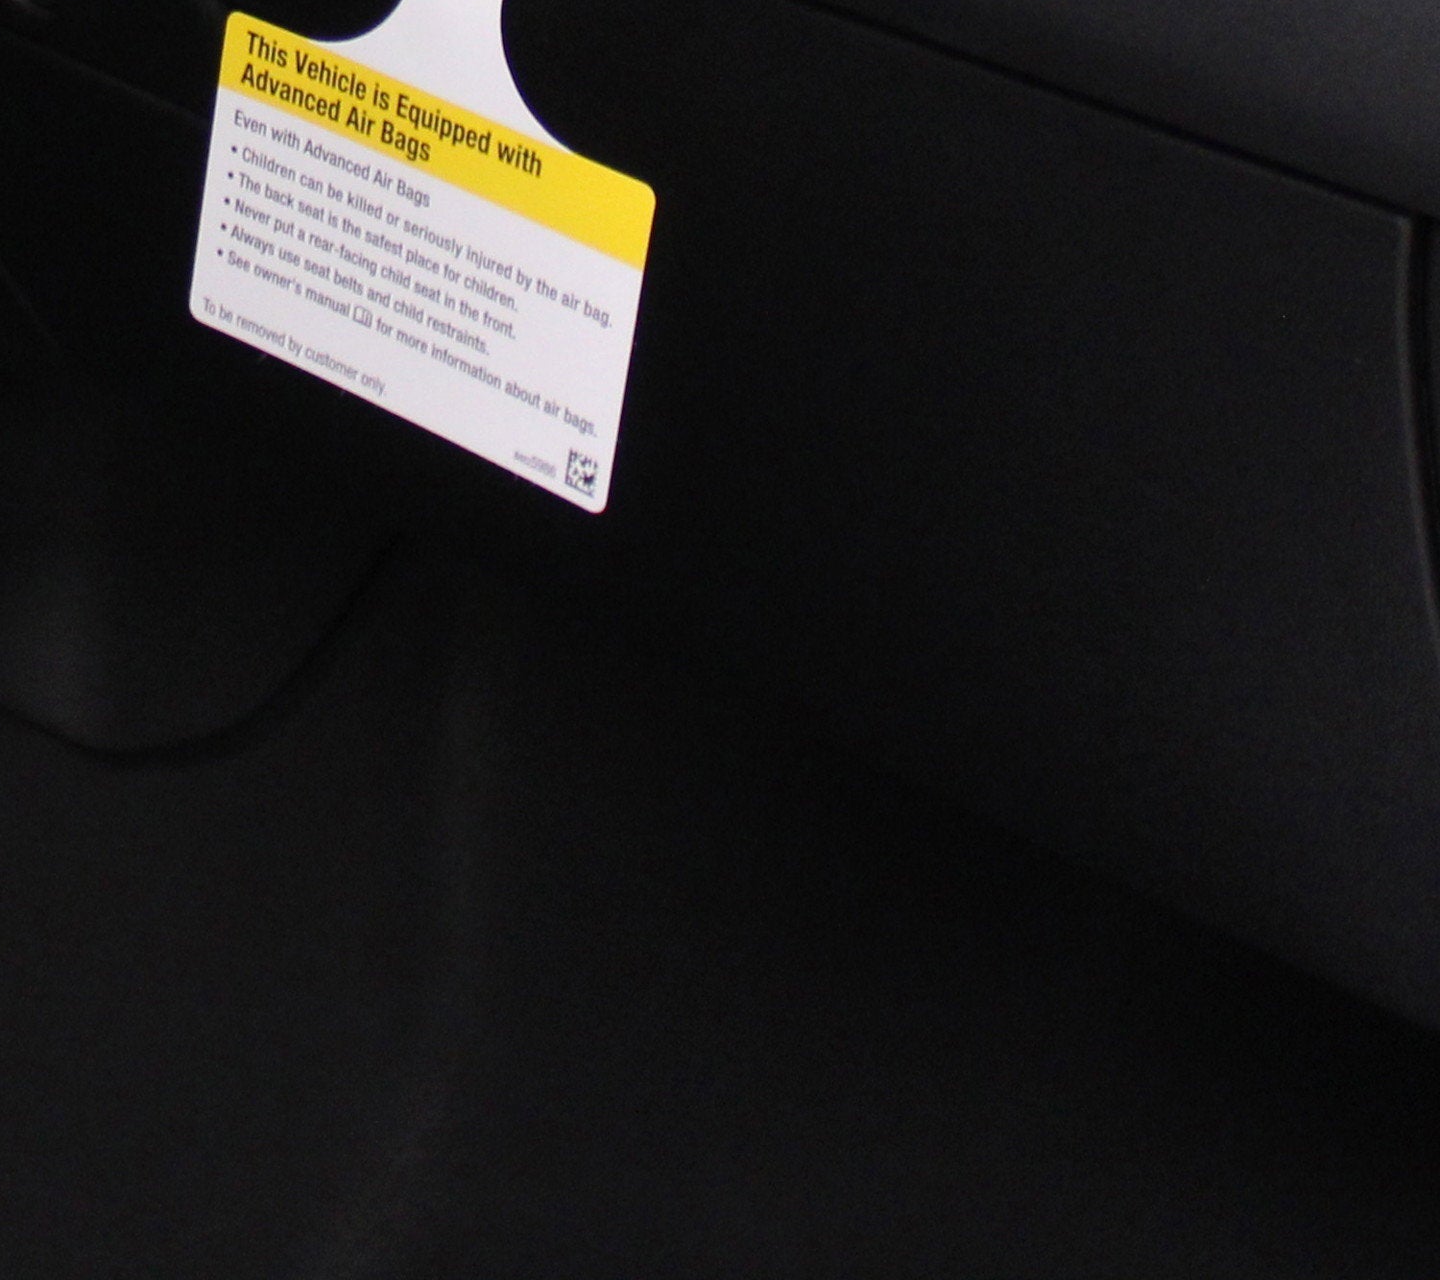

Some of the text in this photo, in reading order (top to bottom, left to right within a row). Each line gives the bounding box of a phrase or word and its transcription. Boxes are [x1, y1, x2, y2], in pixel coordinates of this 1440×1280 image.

[233, 107, 430, 207] Even with Advanced Air Bags
[239, 61, 430, 162] Advanced Air Bags
[246, 29, 542, 177] This Vehicle is Equipped with
[229, 223, 275, 256] Always
[277, 246, 301, 267] use
[302, 257, 331, 280] seat
[332, 267, 364, 296] belts
[366, 286, 391, 308] and
[392, 299, 424, 324] child
[233, 197, 271, 225] Never
[272, 217, 295, 237] put
[296, 227, 306, 242] a
[307, 232, 378, 277] rear-facing
[379, 264, 411, 289] child
[413, 280, 441, 303] seat
[442, 291, 456, 311] in
[458, 298, 479, 322] the
[238, 170, 261, 195] The
[263, 182, 294, 209] back
[297, 199, 325, 222] seat
[326, 209, 339, 228] is
[341, 216, 362, 238] the
[363, 229, 403, 258] safest
[404, 248, 440, 274] place
[442, 262, 461, 284] for
[241, 145, 296, 181] Children
[298, 173, 324, 194] can
[326, 181, 343, 202] be
[346, 190, 383, 220] killed
[385, 211, 400, 227] or
[402, 218, 463, 259] seriously
[465, 244, 513, 280] injured
[515, 267, 533, 292] by
[535, 277, 558, 301] the
[560, 292, 581, 311] air
[226, 249, 251, 272] See
[304, 286, 351, 317] manual
[375, 315, 394, 336] for
[395, 328, 428, 354] more
[430, 342, 502, 389] information
[503, 380, 541, 409] about
[542, 399, 561, 417] air
